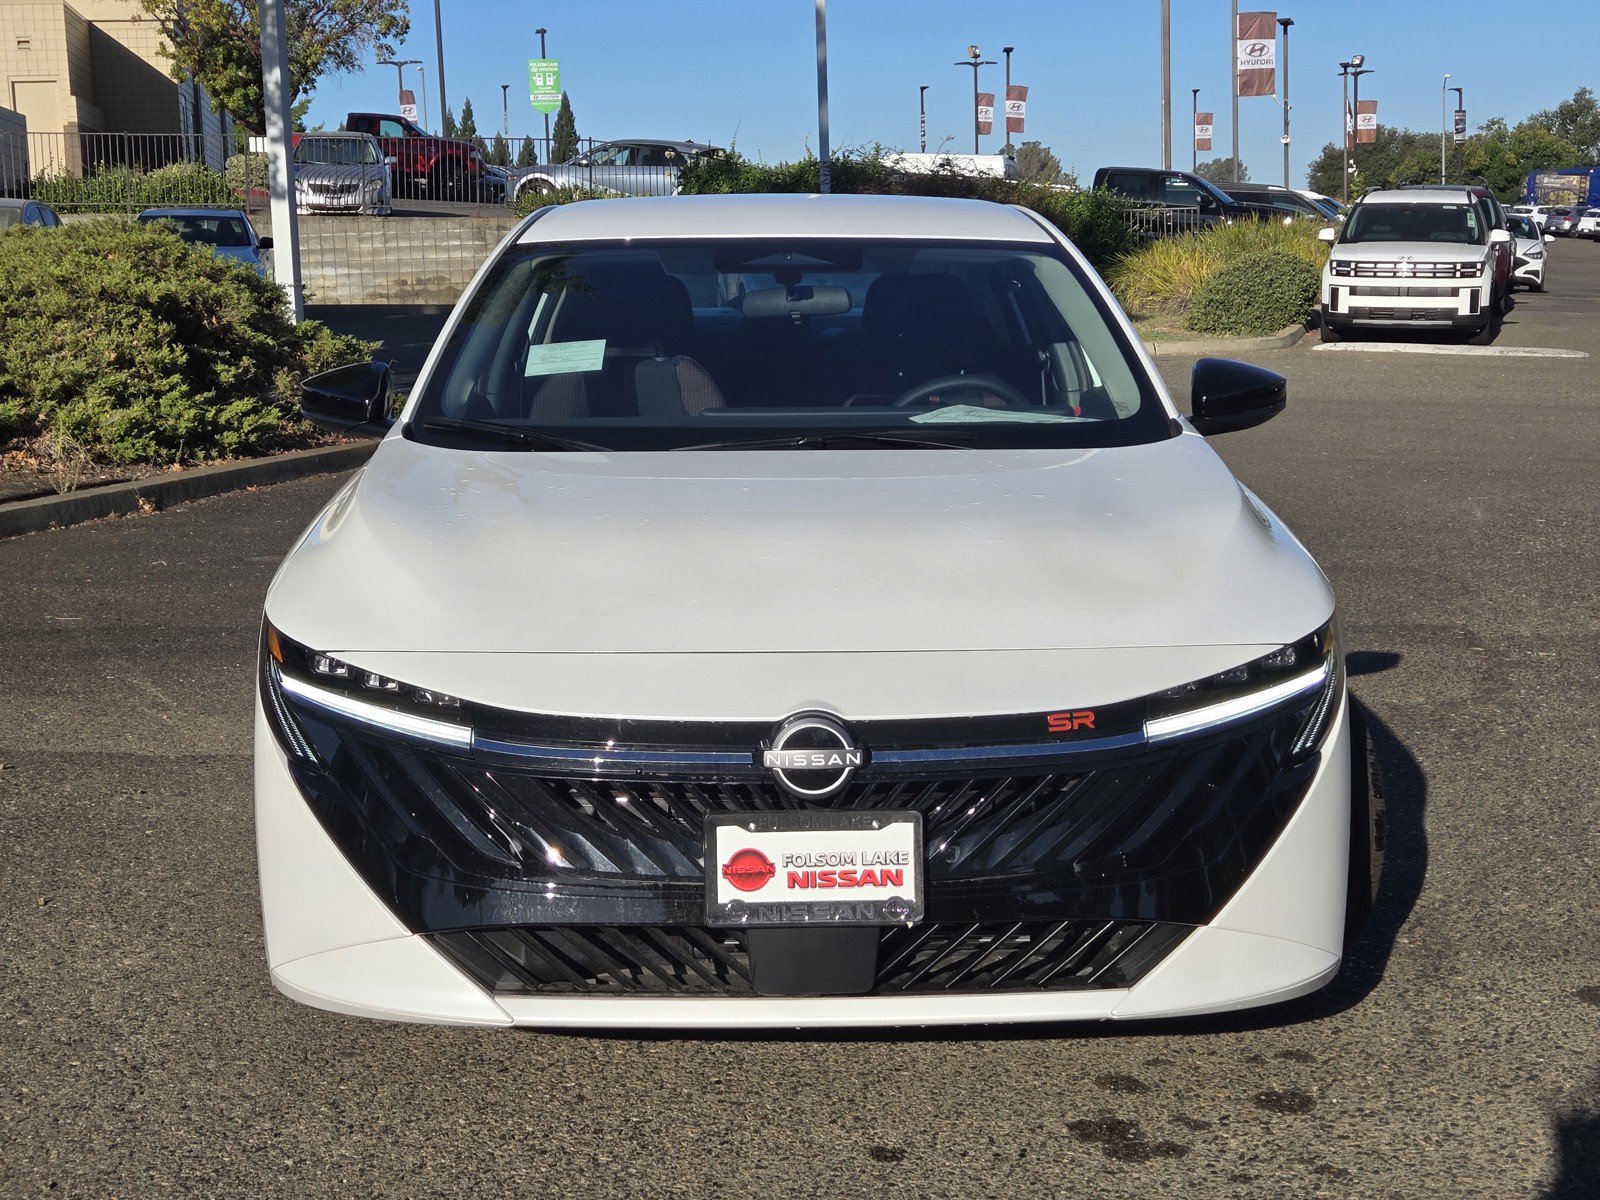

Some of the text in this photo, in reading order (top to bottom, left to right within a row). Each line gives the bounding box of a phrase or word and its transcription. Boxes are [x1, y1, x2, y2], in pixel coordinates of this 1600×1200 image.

[1047, 711, 1096, 732] SR
[766, 752, 861, 766] NISSAN
[782, 851, 909, 868] FOLSOM LAKE
[722, 864, 776, 875] NISSAN
[787, 868, 904, 889] NISSAN
[759, 902, 876, 921] NISSAN
